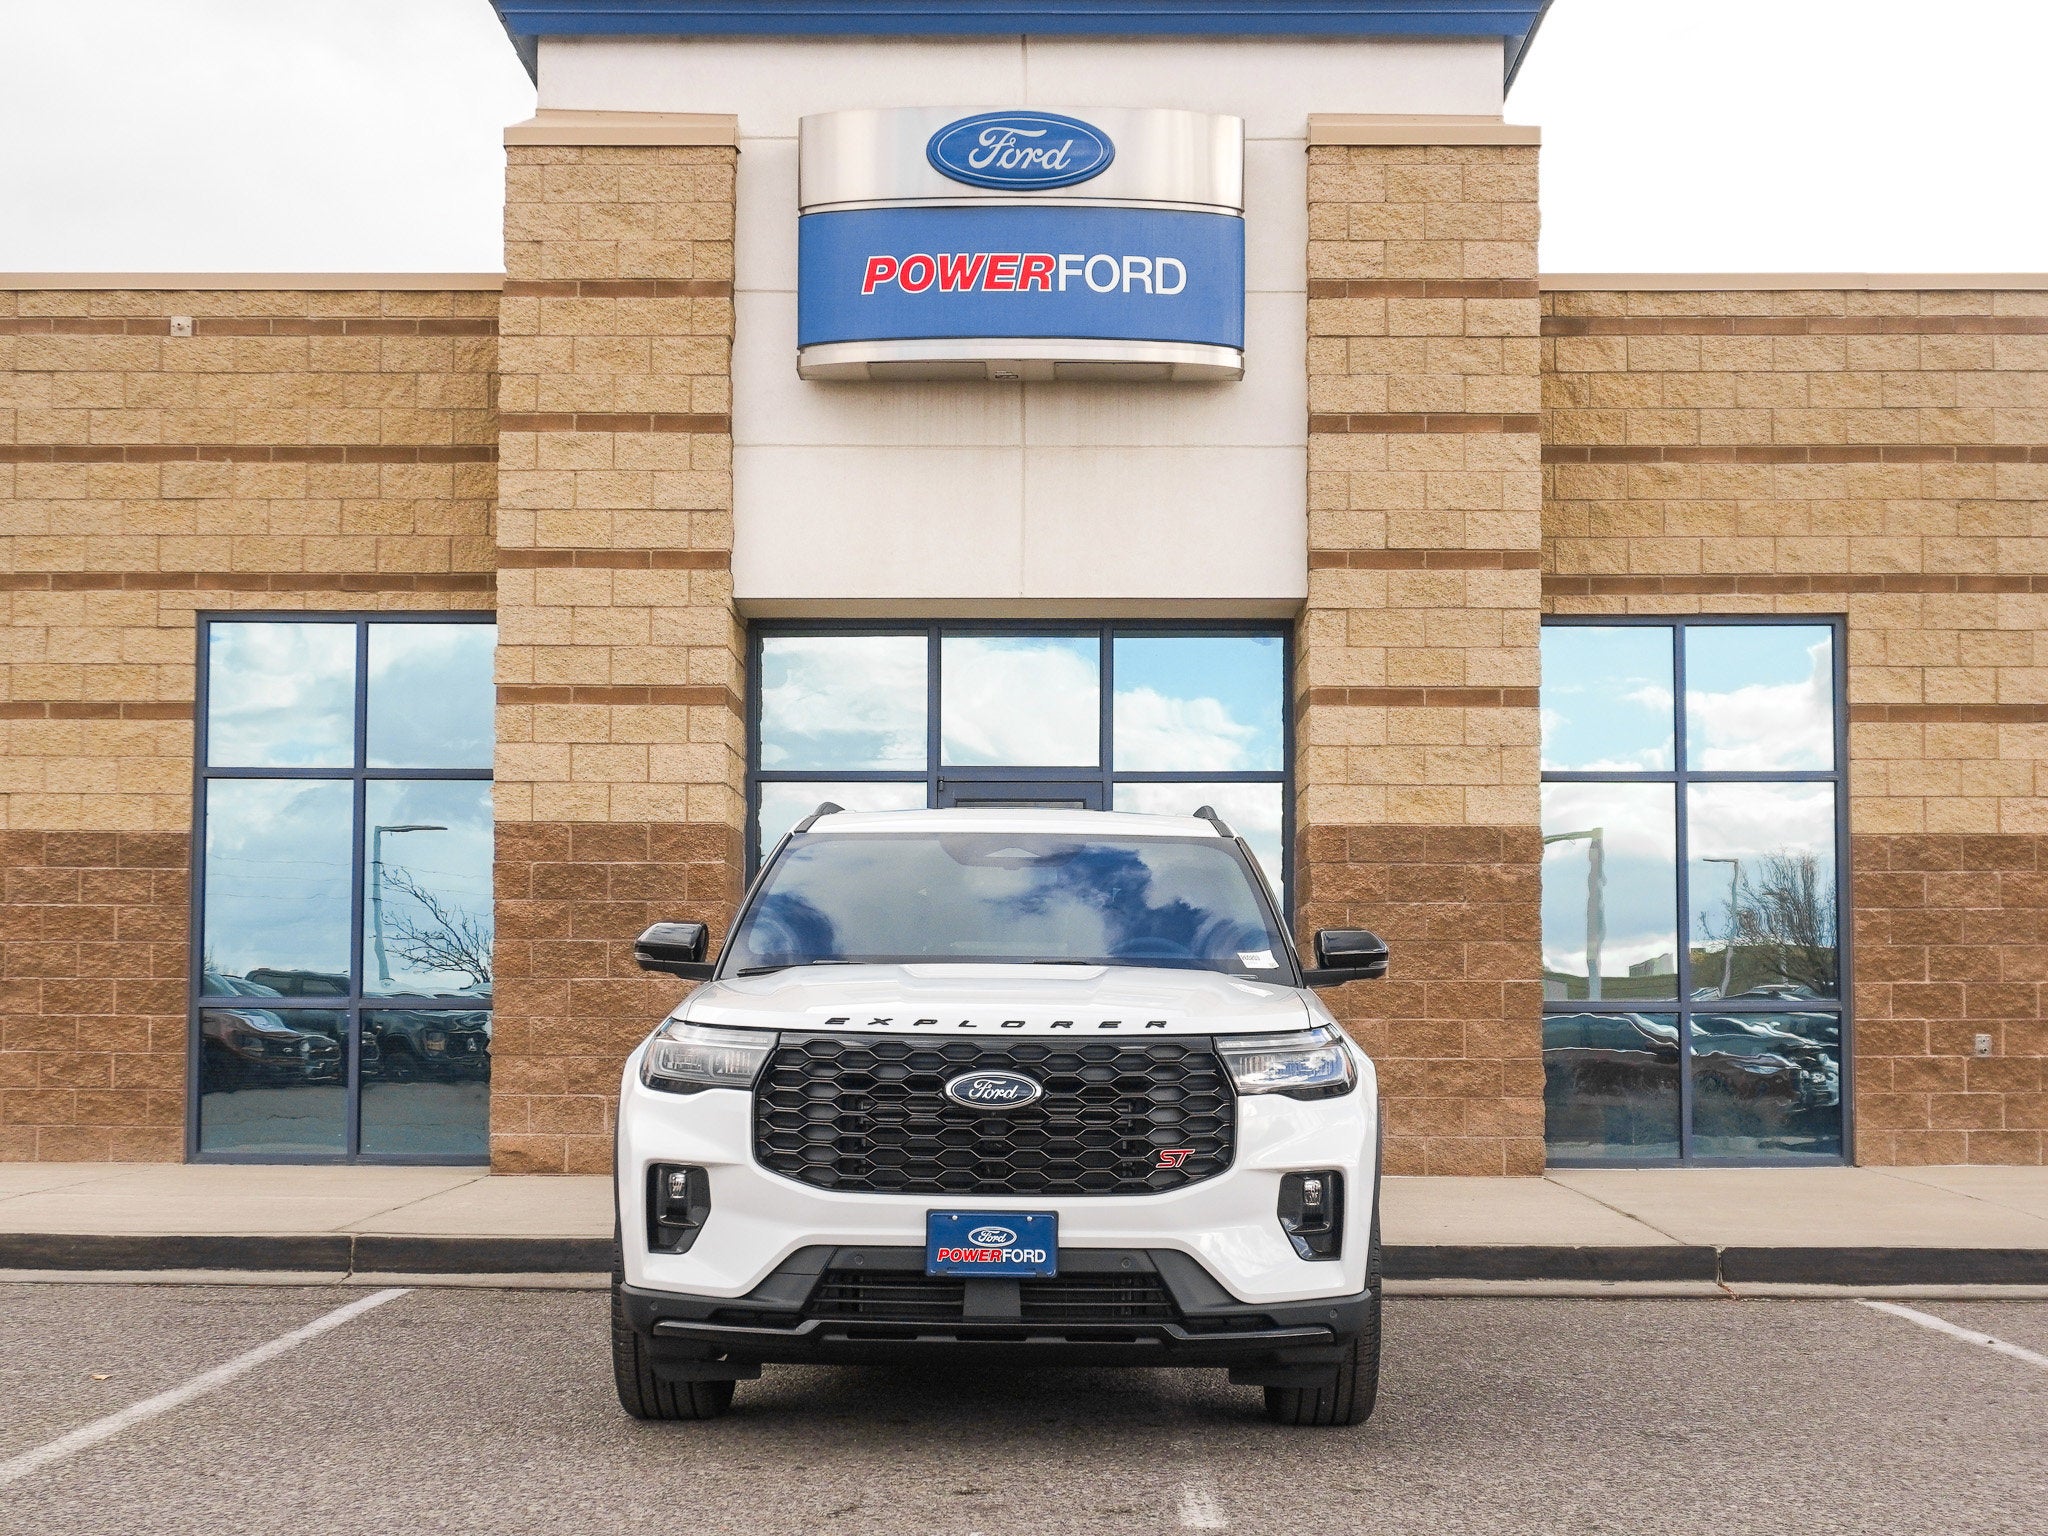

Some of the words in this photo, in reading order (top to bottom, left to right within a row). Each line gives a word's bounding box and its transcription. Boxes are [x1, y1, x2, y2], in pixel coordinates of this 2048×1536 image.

[968, 126, 1073, 171] Ford
[824, 1017, 1167, 1029] EXPLORER
[968, 1079, 1019, 1100] Ford
[1155, 1149, 1196, 1168] ST
[977, 1230, 1007, 1243] Ford
